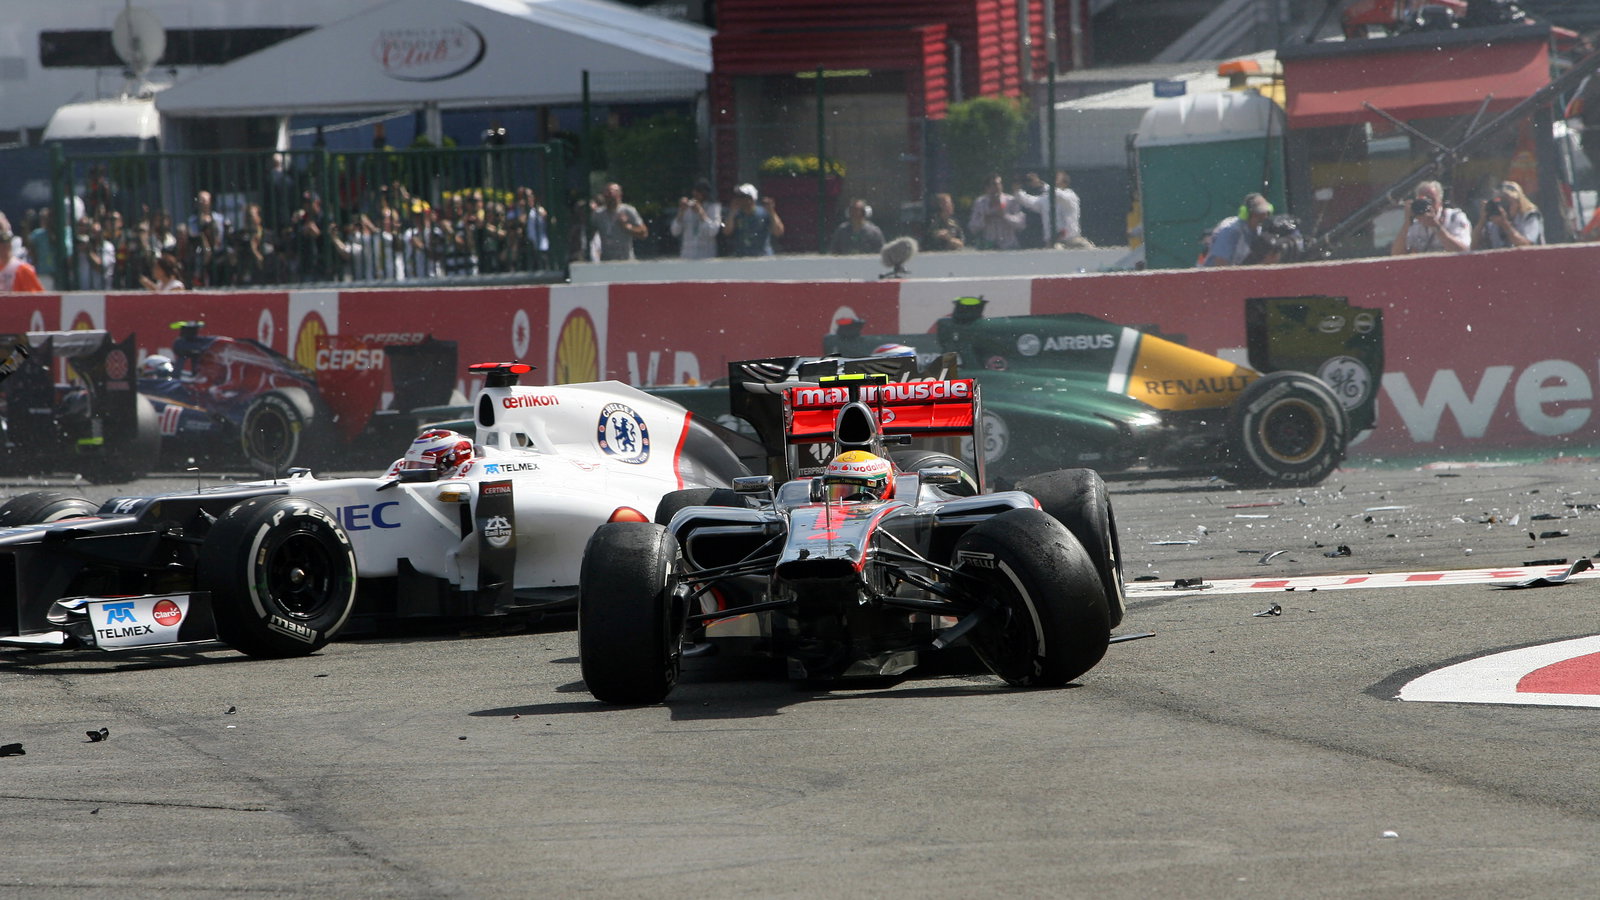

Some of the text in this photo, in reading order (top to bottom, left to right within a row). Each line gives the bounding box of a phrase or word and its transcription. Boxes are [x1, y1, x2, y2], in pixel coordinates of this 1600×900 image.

[1043, 334, 1115, 351] AIRBUS
[316, 348, 385, 371] CEPSA
[1144, 375, 1250, 396] RENAULT
[1382, 358, 1593, 443] we
[499, 462, 541, 473] TELMEX
[484, 486, 511, 495] CERTINA
[112, 498, 143, 514] 14
[292, 506, 349, 545] ZERO
[153, 606, 177, 619] Claro
[97, 624, 154, 640] TELMEX
